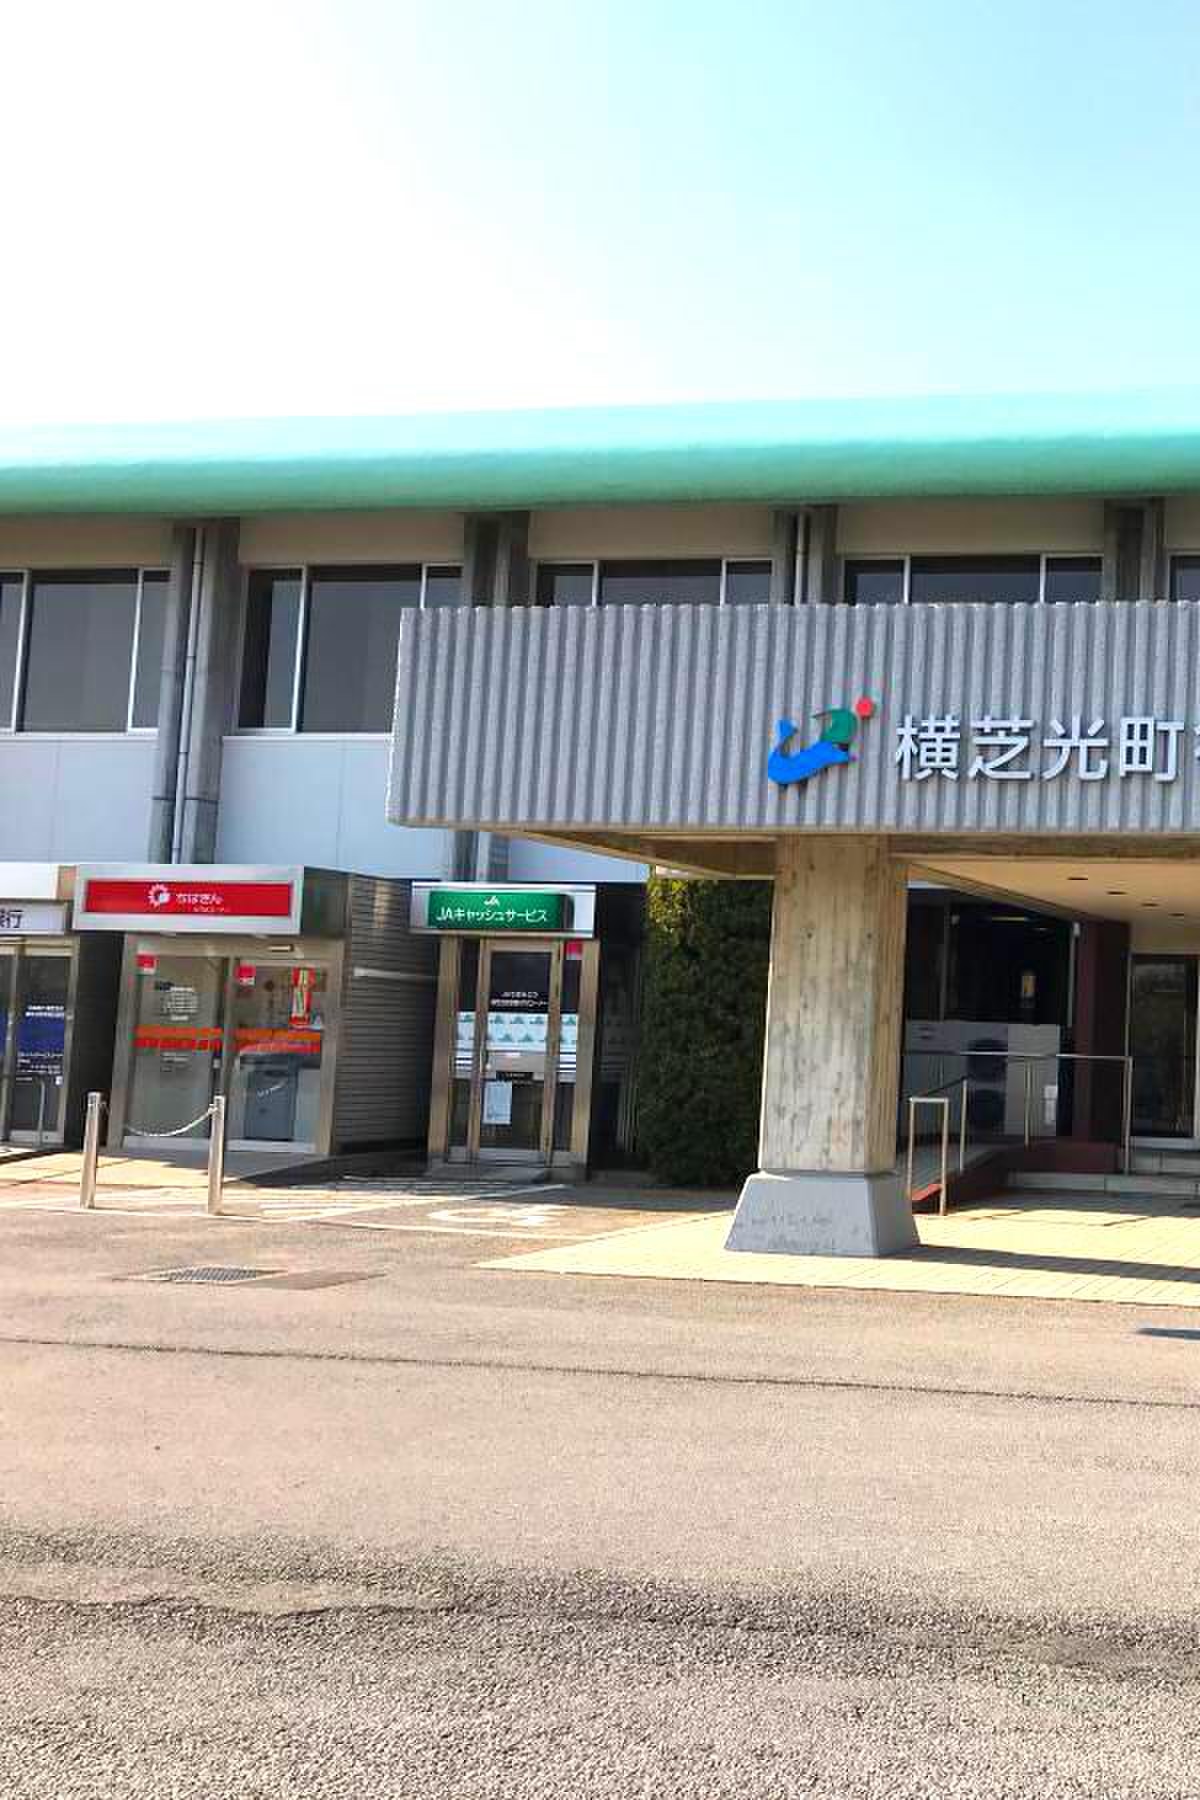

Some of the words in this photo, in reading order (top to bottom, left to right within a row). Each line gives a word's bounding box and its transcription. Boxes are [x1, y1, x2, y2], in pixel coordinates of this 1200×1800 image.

[436, 906, 547, 922] JAキャッシュサービス
